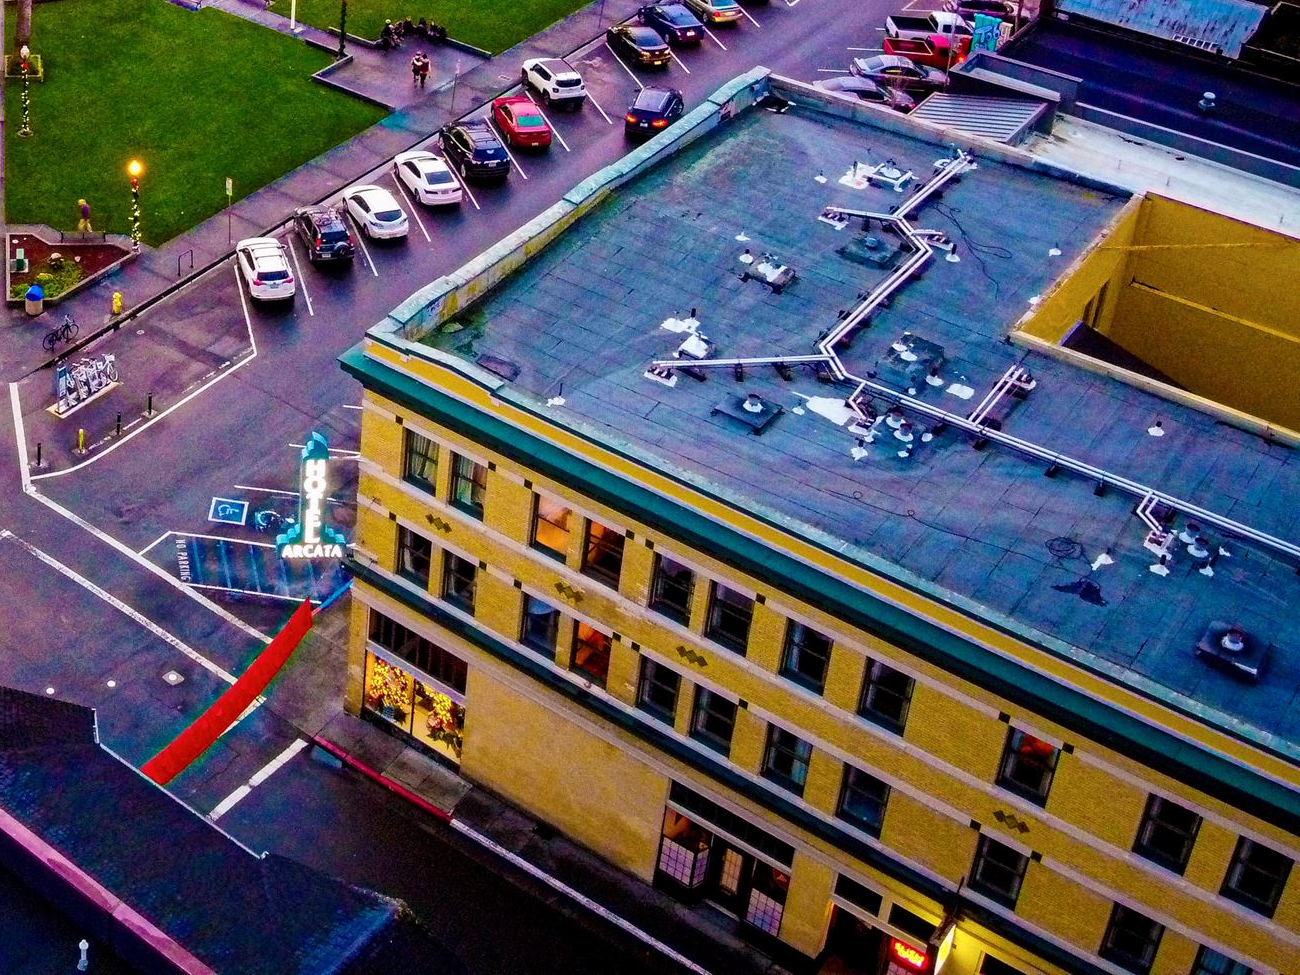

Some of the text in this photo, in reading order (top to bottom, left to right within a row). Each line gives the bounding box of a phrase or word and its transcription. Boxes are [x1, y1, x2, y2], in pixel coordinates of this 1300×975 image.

[303, 459, 327, 544] HOTEL
[175, 539, 187, 549] NO
[282, 544, 342, 559] ARCATA
[177, 552, 191, 583] PARKING
